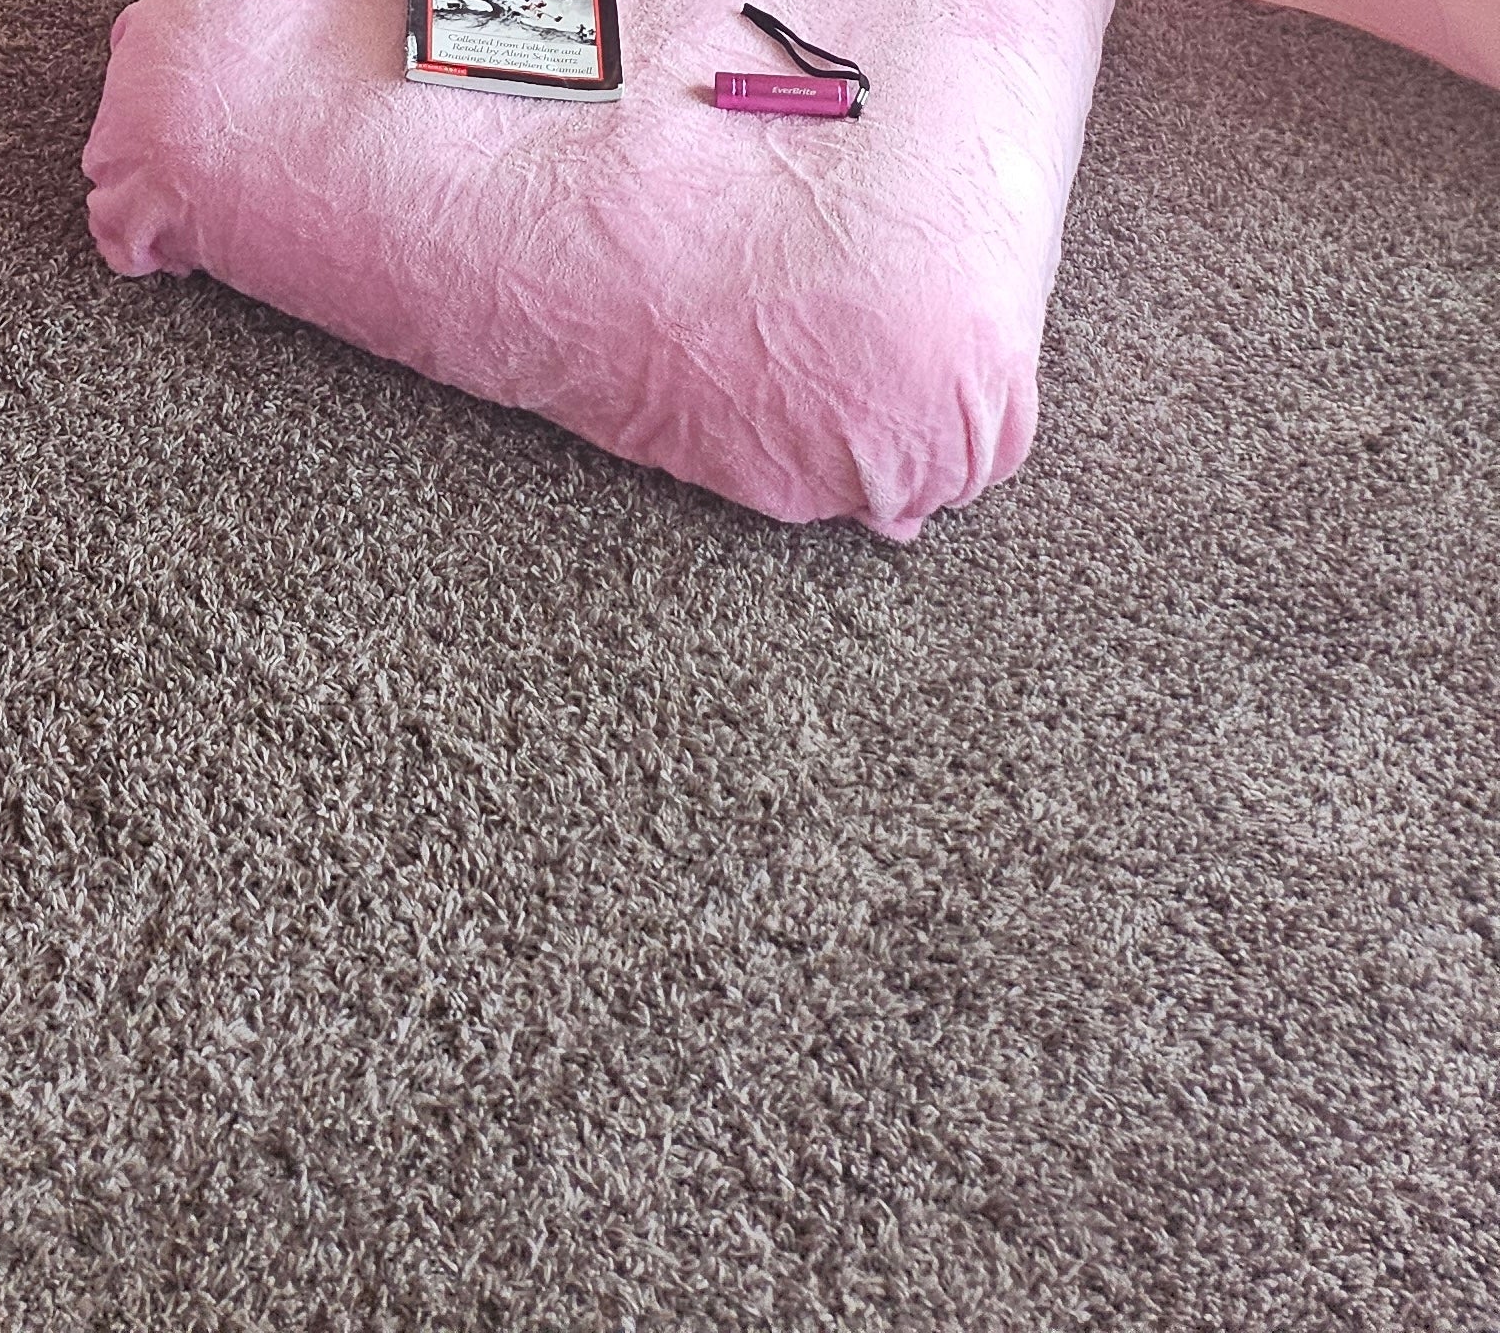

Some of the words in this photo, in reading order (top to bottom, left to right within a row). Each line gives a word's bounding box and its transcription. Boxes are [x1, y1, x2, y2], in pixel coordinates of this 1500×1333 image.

[448, 33, 494, 47] Collected
[494, 35, 519, 50] from
[521, 38, 560, 55] Folklore
[560, 46, 582, 56] and
[452, 42, 484, 54] Retold
[486, 44, 499, 57] by
[500, 46, 531, 60] Alvin
[532, 51, 579, 65] Schwartz
[438, 49, 487, 64] Drawings
[488, 54, 502, 66] by
[504, 57, 544, 72] Stephen
[771, 86, 817, 97] EverBrite
